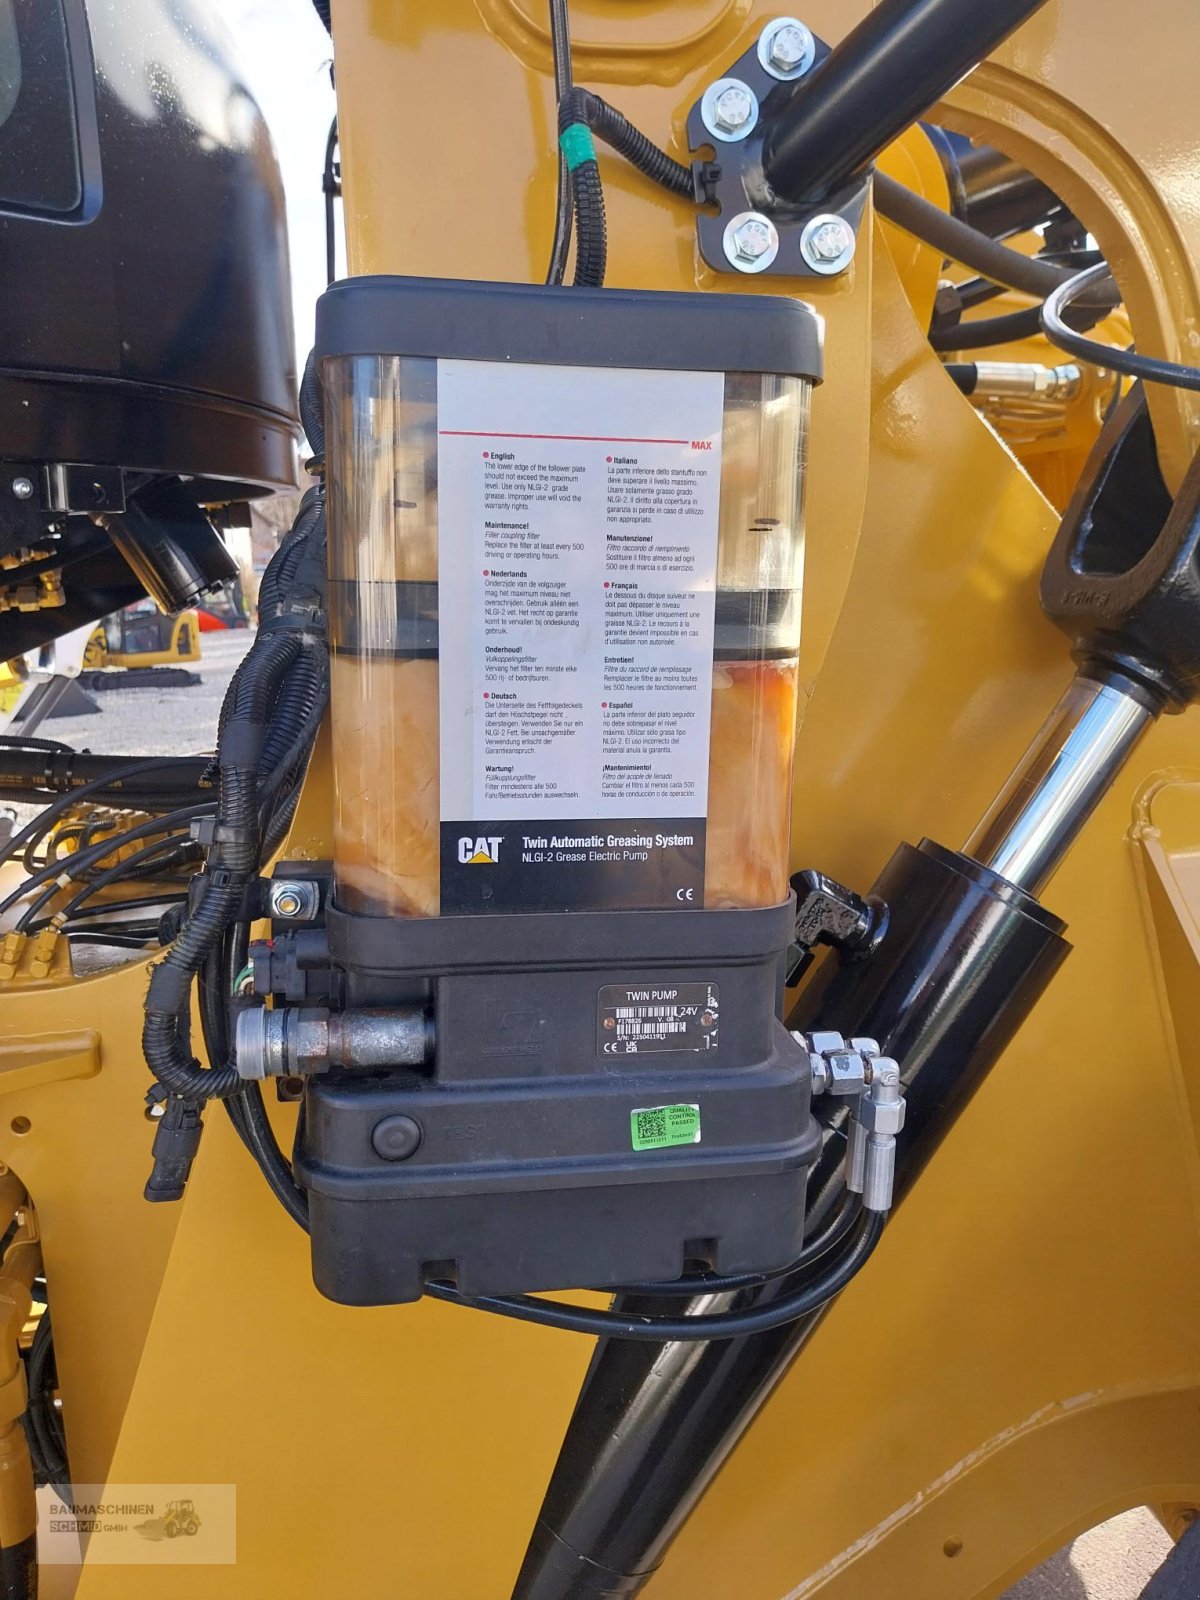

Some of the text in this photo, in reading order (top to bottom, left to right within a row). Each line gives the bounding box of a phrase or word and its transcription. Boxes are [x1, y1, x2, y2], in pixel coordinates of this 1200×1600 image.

[691, 441, 712, 450] MAX
[491, 452, 514, 461] English
[485, 462, 495, 470] The
[515, 463, 528, 472] edge
[548, 464, 570, 472] follower
[572, 465, 585, 474] plate
[608, 466, 614, 474] La
[616, 466, 631, 475] parte
[632, 467, 654, 475] inferiore
[671, 468, 695, 476] stantuffo
[485, 472, 504, 480] should
[517, 473, 537, 481] exceed
[550, 474, 578, 482] maximum
[654, 477, 669, 485] livello
[502, 482, 512, 490] Use
[514, 483, 526, 491] only
[528, 483, 548, 491] NLGI-2
[552, 484, 568, 492] grade
[608, 486, 692, 496] Usare solamente grasso grado
[485, 493, 506, 501] grease.
[508, 493, 534, 502] Improper
[572, 494, 581, 502] the
[485, 501, 510, 510] warranty
[501, 531, 525, 540] coupling
[607, 534, 652, 542] Manutenzione!
[485, 541, 507, 550] Replace
[509, 541, 518, 549] the
[541, 542, 554, 550] least
[485, 550, 504, 559] driving
[514, 551, 540, 560] operating
[485, 579, 515, 588] Onderzijde
[538, 580, 566, 589] volgzuiger
[611, 582, 637, 590] Français
[485, 590, 497, 598] mag
[511, 589, 538, 597] maximum
[647, 591, 665, 600] disque
[605, 600, 615, 608] doit
[629, 601, 654, 609] dépasser
[519, 608, 528, 616] Het
[530, 608, 545, 616] recht
[555, 609, 578, 617] garantie
[605, 628, 627, 637] garantie
[650, 629, 679, 637] impossible
[627, 719, 656, 728] sobrepasar
[522, 834, 694, 850] Twin Automatic Greasing System
[458, 836, 505, 864] CAT
[522, 850, 648, 863] NLGI-2 Grease Electric Pump
[676, 888, 694, 901] CE
[626, 990, 678, 1001] TWIN PUMP
[680, 1006, 699, 1017] 24V
[603, 1042, 618, 1053] CE
